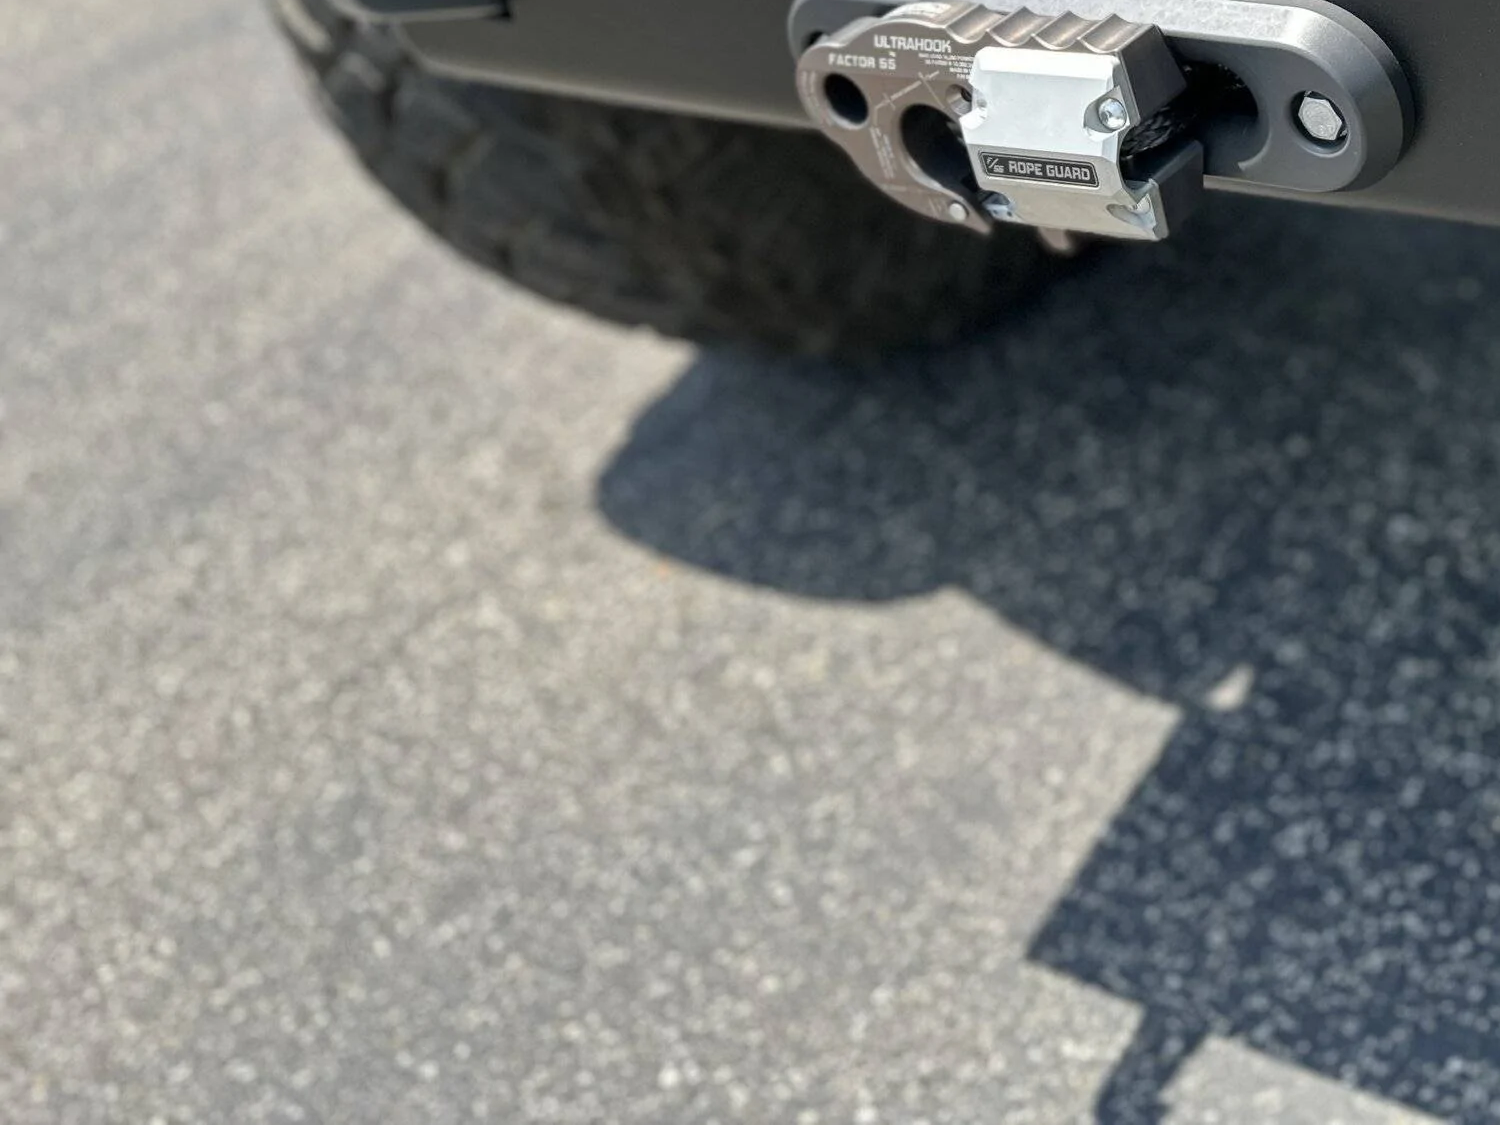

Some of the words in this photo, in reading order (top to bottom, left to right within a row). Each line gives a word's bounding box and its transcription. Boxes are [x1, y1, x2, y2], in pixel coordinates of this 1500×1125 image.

[873, 34, 952, 53] ULTRAHOOK
[828, 53, 875, 69] FACTOR
[878, 57, 897, 70] 55
[1008, 160, 1043, 176] ROPE
[1045, 165, 1091, 181] GUARD
